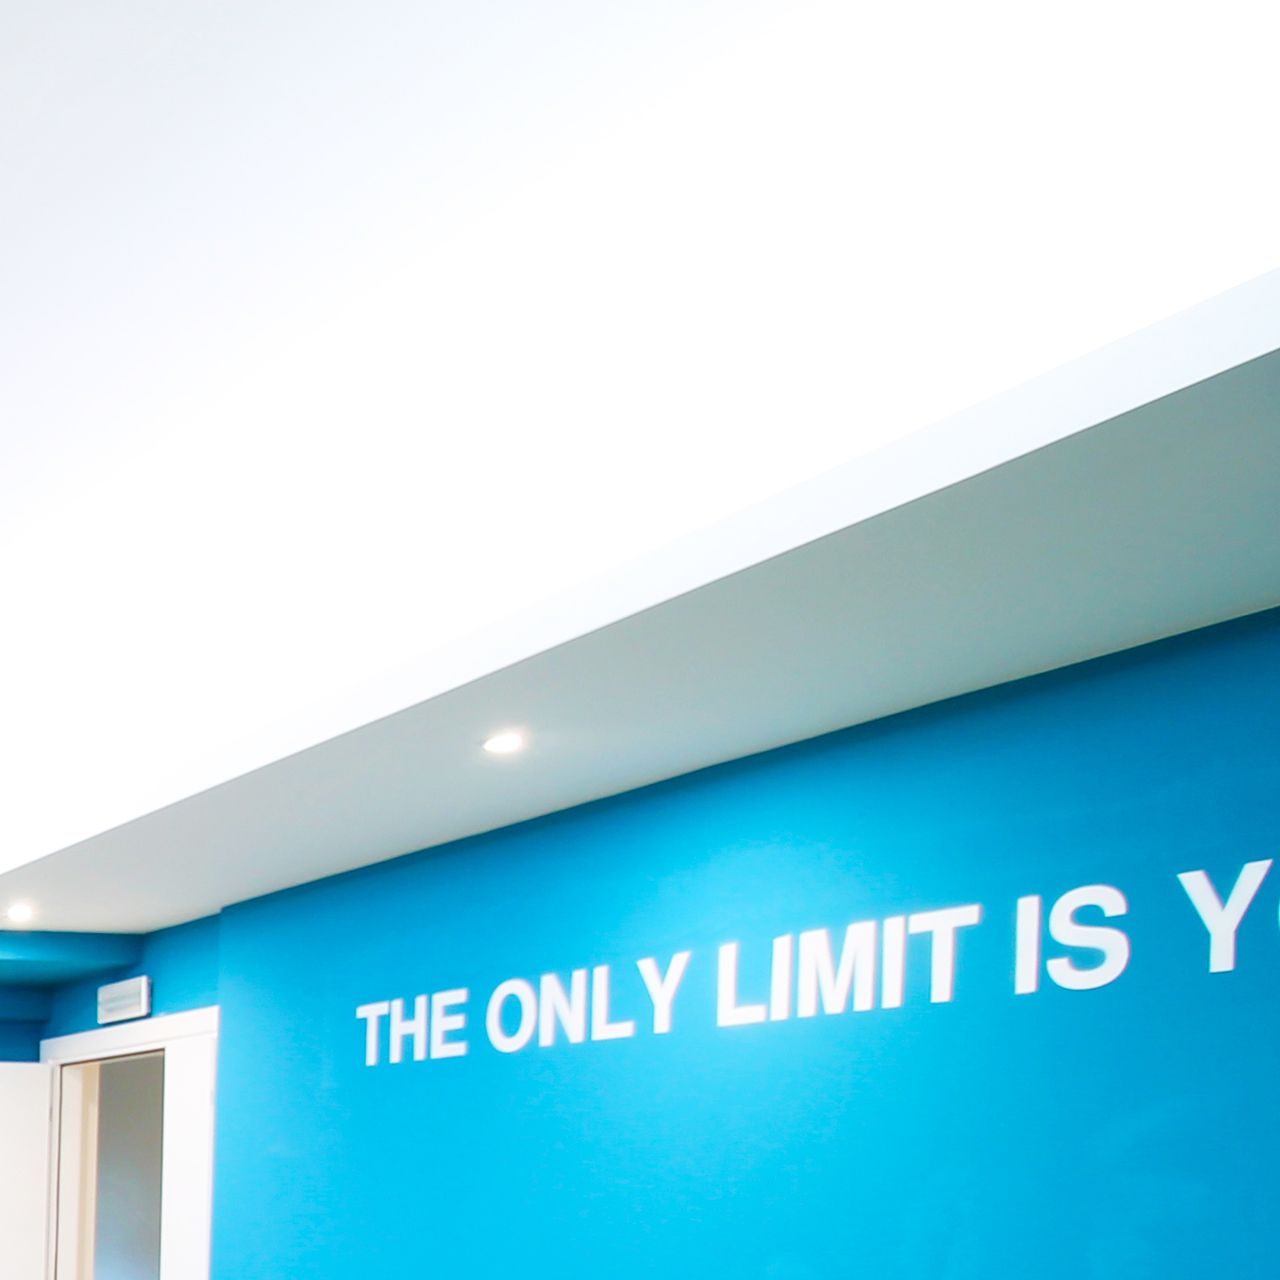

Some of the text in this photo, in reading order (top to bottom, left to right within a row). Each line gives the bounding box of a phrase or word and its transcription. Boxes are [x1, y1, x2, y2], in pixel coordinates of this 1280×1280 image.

[355, 858, 1280, 1067] THE ONLY LIMIT IS Y
